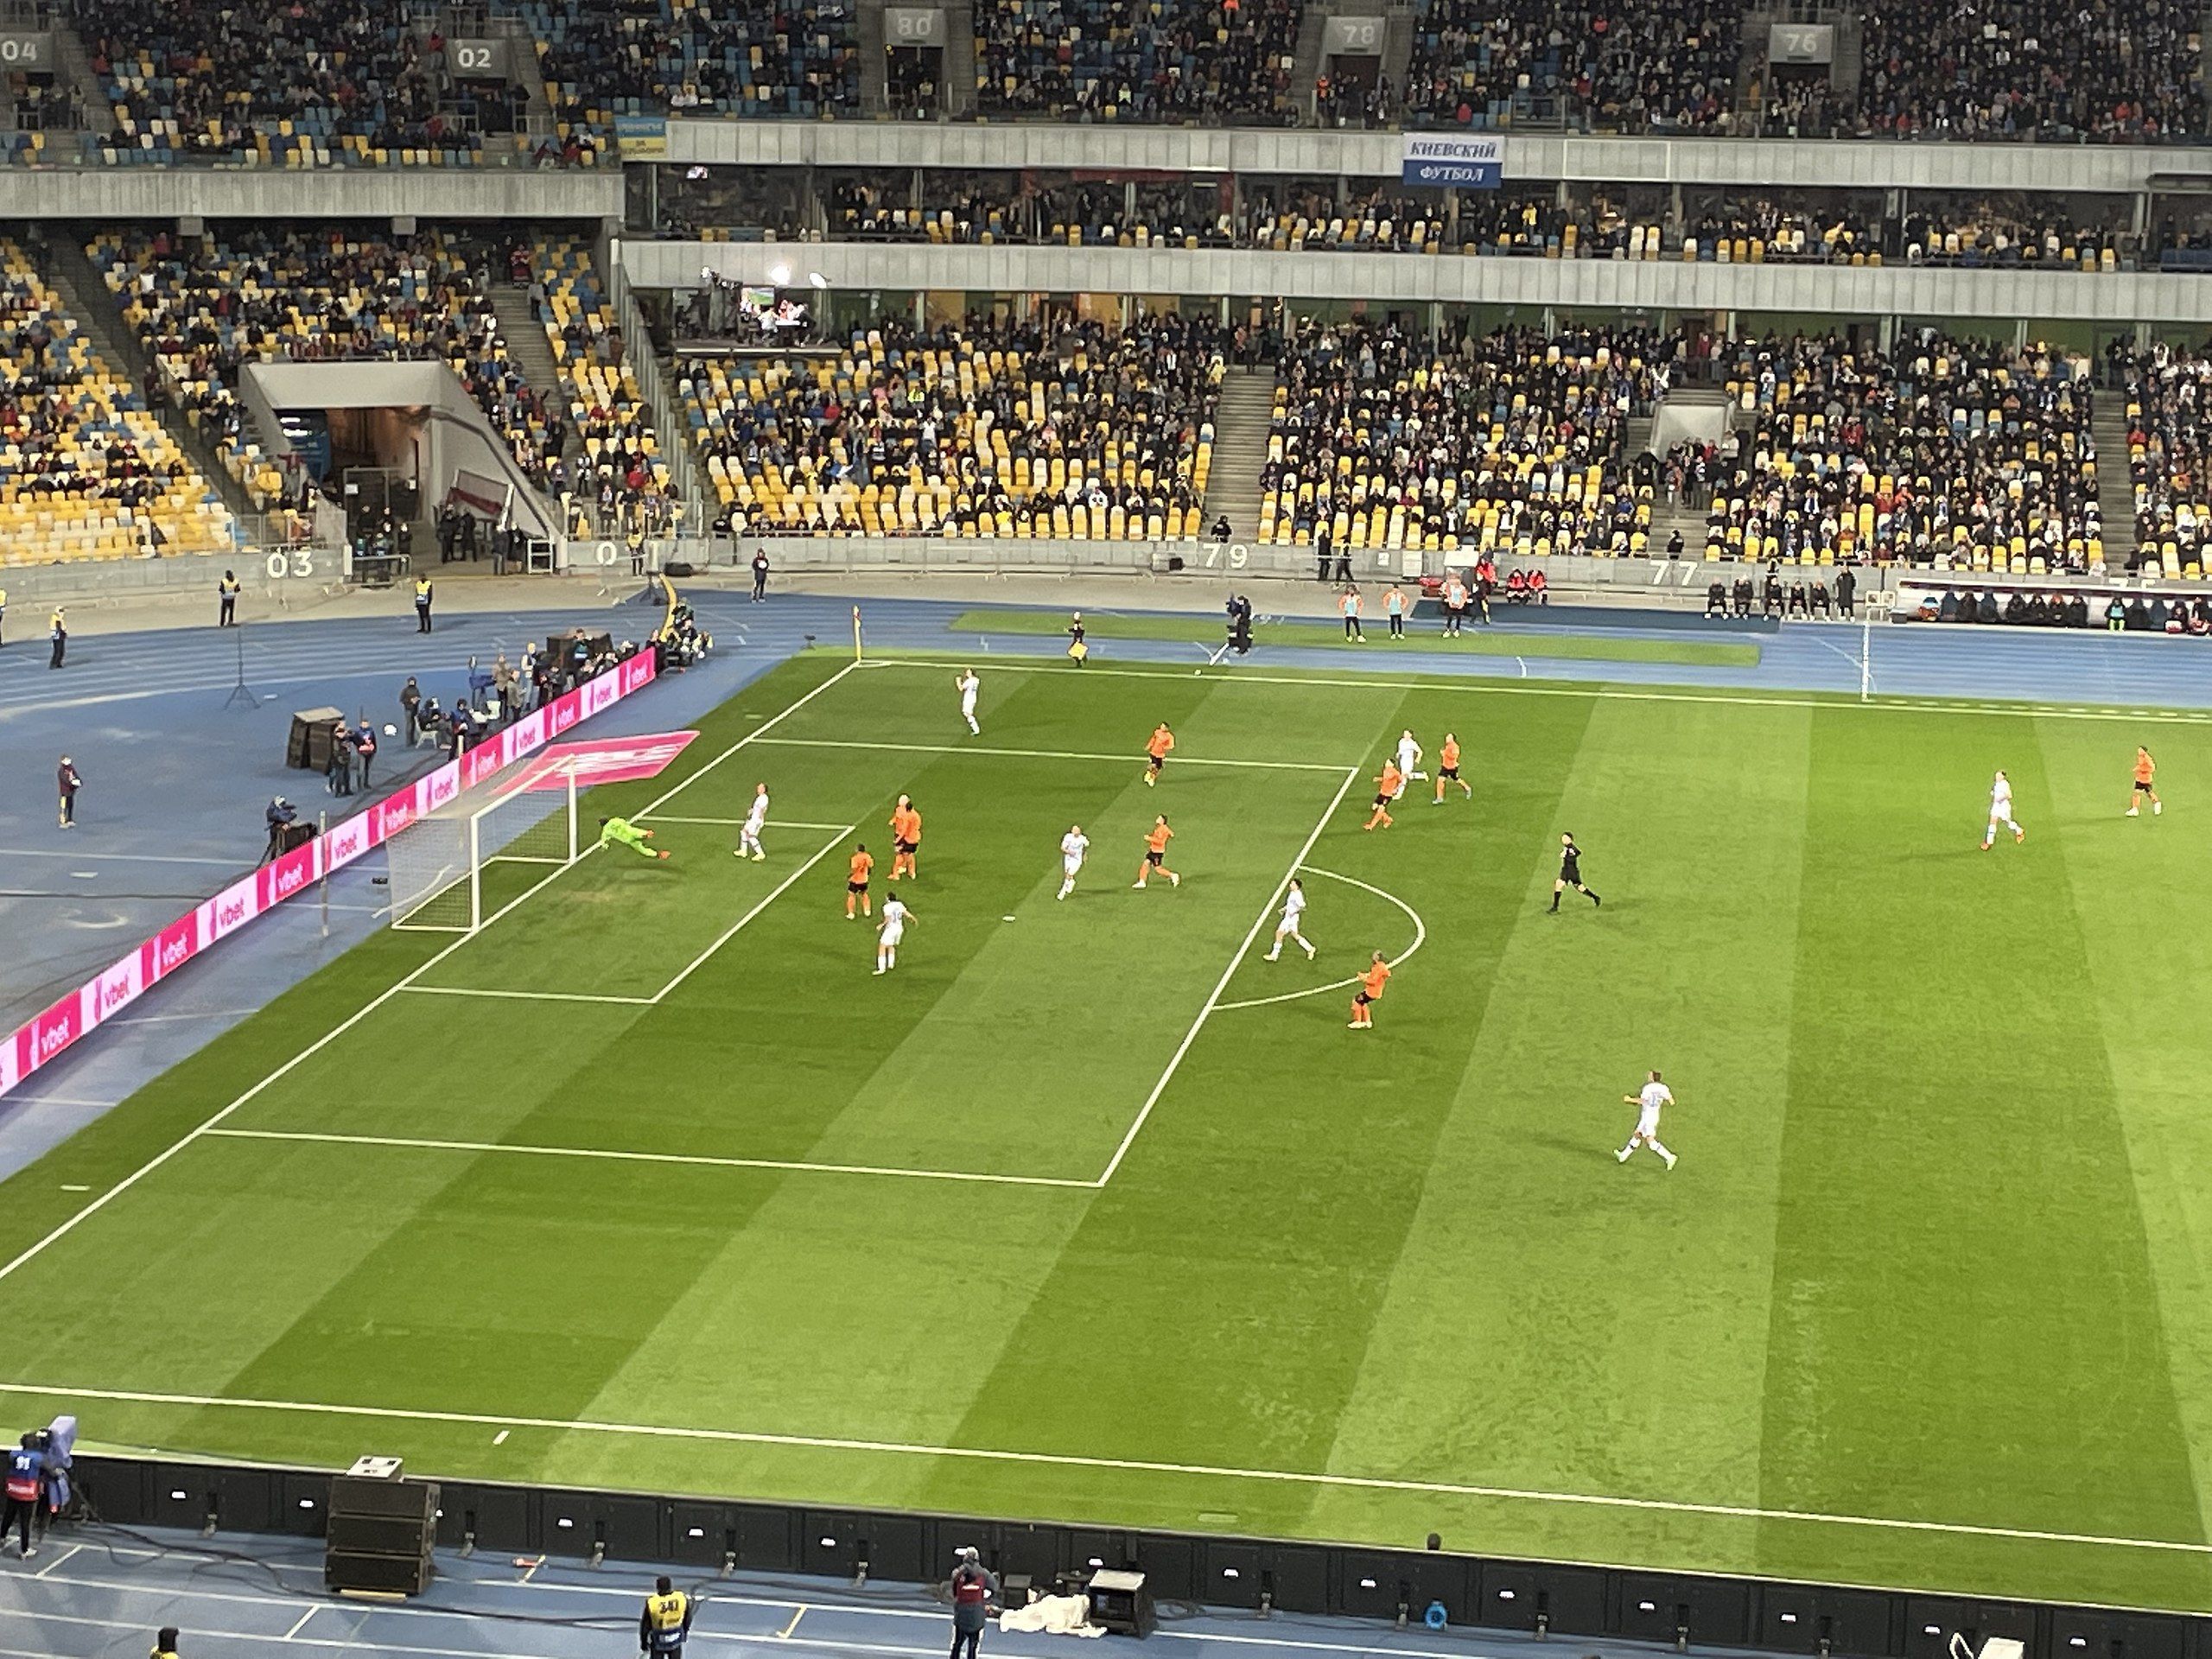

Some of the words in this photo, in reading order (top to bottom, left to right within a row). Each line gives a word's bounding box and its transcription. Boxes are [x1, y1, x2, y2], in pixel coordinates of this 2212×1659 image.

[898, 17, 931, 35] 80
[1343, 26, 1374, 44] 78
[2, 41, 36, 60] 04
[1785, 33, 1817, 52] 76
[458, 48, 492, 67] 02
[1410, 141, 1497, 157] КИЕВСКИЙ
[1420, 165, 1484, 182] ФУТБОЛ
[266, 550, 313, 579] 03
[1203, 543, 1248, 568] 79
[1649, 559, 1698, 586] 77
[219, 897, 245, 929] vbet
[162, 932, 188, 966] vbet
[105, 973, 130, 1008] vbet
[41, 1015, 70, 1055] vbet
